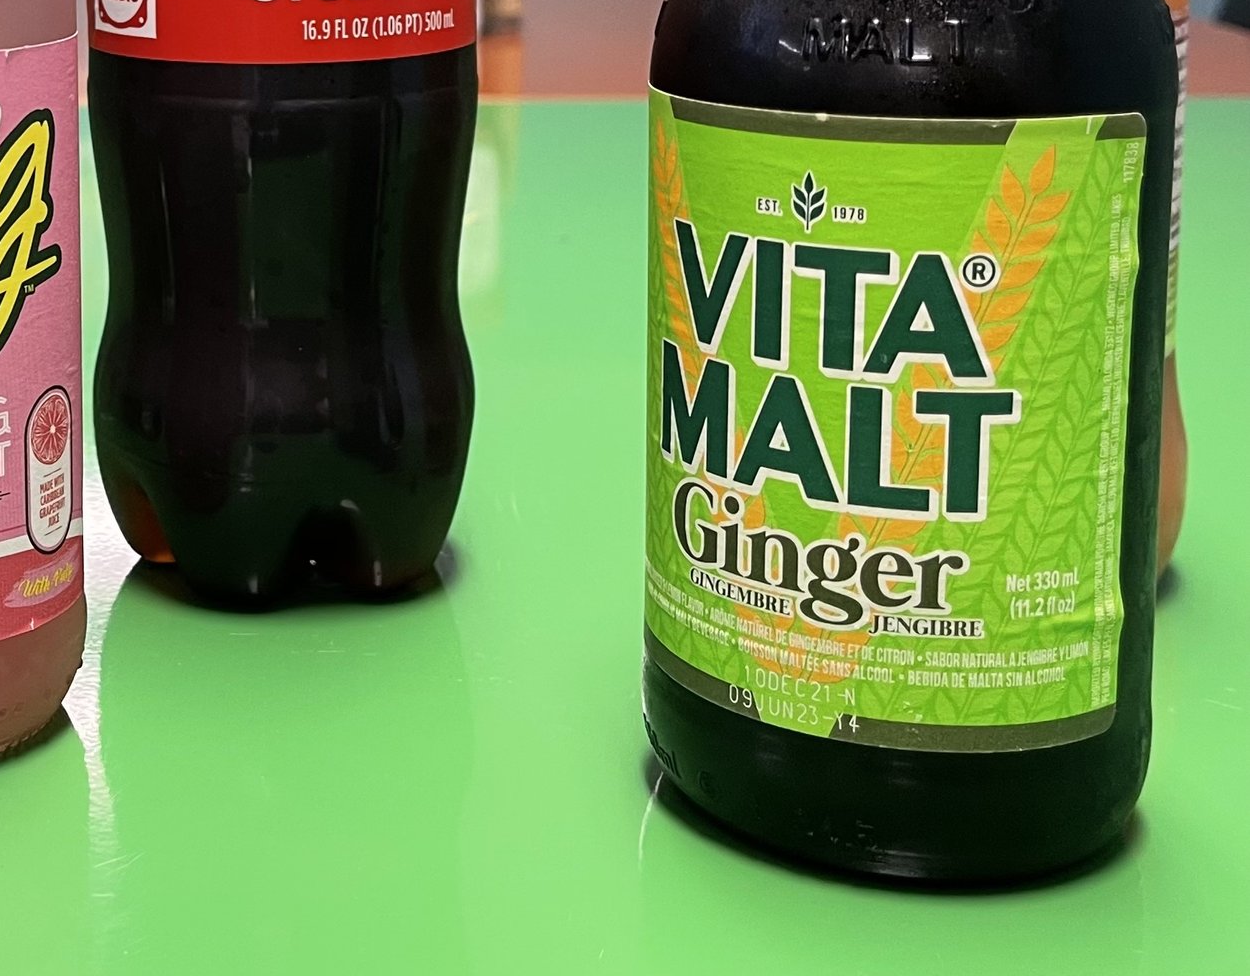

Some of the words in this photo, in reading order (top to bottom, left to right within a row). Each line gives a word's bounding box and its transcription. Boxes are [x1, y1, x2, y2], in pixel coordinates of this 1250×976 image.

[301, 15, 331, 42] 16.9
[334, 16, 350, 40] FL
[352, 15, 369, 39] OZ
[371, 13, 402, 40] (1.06
[404, 11, 423, 37] PT)
[425, 9, 443, 33] 500
[444, 7, 455, 30] mL
[800, 16, 966, 66] MALT
[1123, 142, 1139, 184] 117838
[756, 196, 782, 215] EST.
[831, 204, 867, 223] 1978
[1108, 255, 1119, 282] GROUP
[674, 217, 996, 386] VITA
[660, 337, 1022, 522] MALT
[671, 476, 970, 626] Ginger
[689, 566, 793, 618] GINGEMBRE
[1006, 573, 1031, 593] Net
[1033, 570, 1060, 591] 330
[1062, 566, 1081, 588] mL
[1010, 596, 1045, 620] (11.2
[1045, 594, 1057, 616] fl
[1057, 591, 1076, 614] oz)
[868, 615, 984, 639] JENGIBRE
[692, 614, 730, 646] BEVERAGE
[737, 636, 778, 663] BOISSON
[779, 646, 821, 672] MALTÉE
[822, 659, 851, 678] SANS
[853, 664, 895, 684] ALCOOL
[907, 670, 948, 688] BEBIDA
[951, 672, 965, 688] DE
[968, 672, 1004, 689] MALTA
[1005, 671, 1023, 688] SIN
[1024, 665, 1067, 686] ALCOHOL
[774, 629, 788, 646] DE
[788, 632, 846, 658] GINGEMBRE
[847, 643, 860, 659] ET
[861, 645, 875, 662] DE
[876, 646, 915, 666] CITRON
[925, 650, 961, 669] SABOR
[961, 653, 1009, 670] NATURAL
[1009, 652, 1017, 669] A
[1016, 645, 1058, 668] JENGIBRE
[1058, 646, 1066, 662] Y
